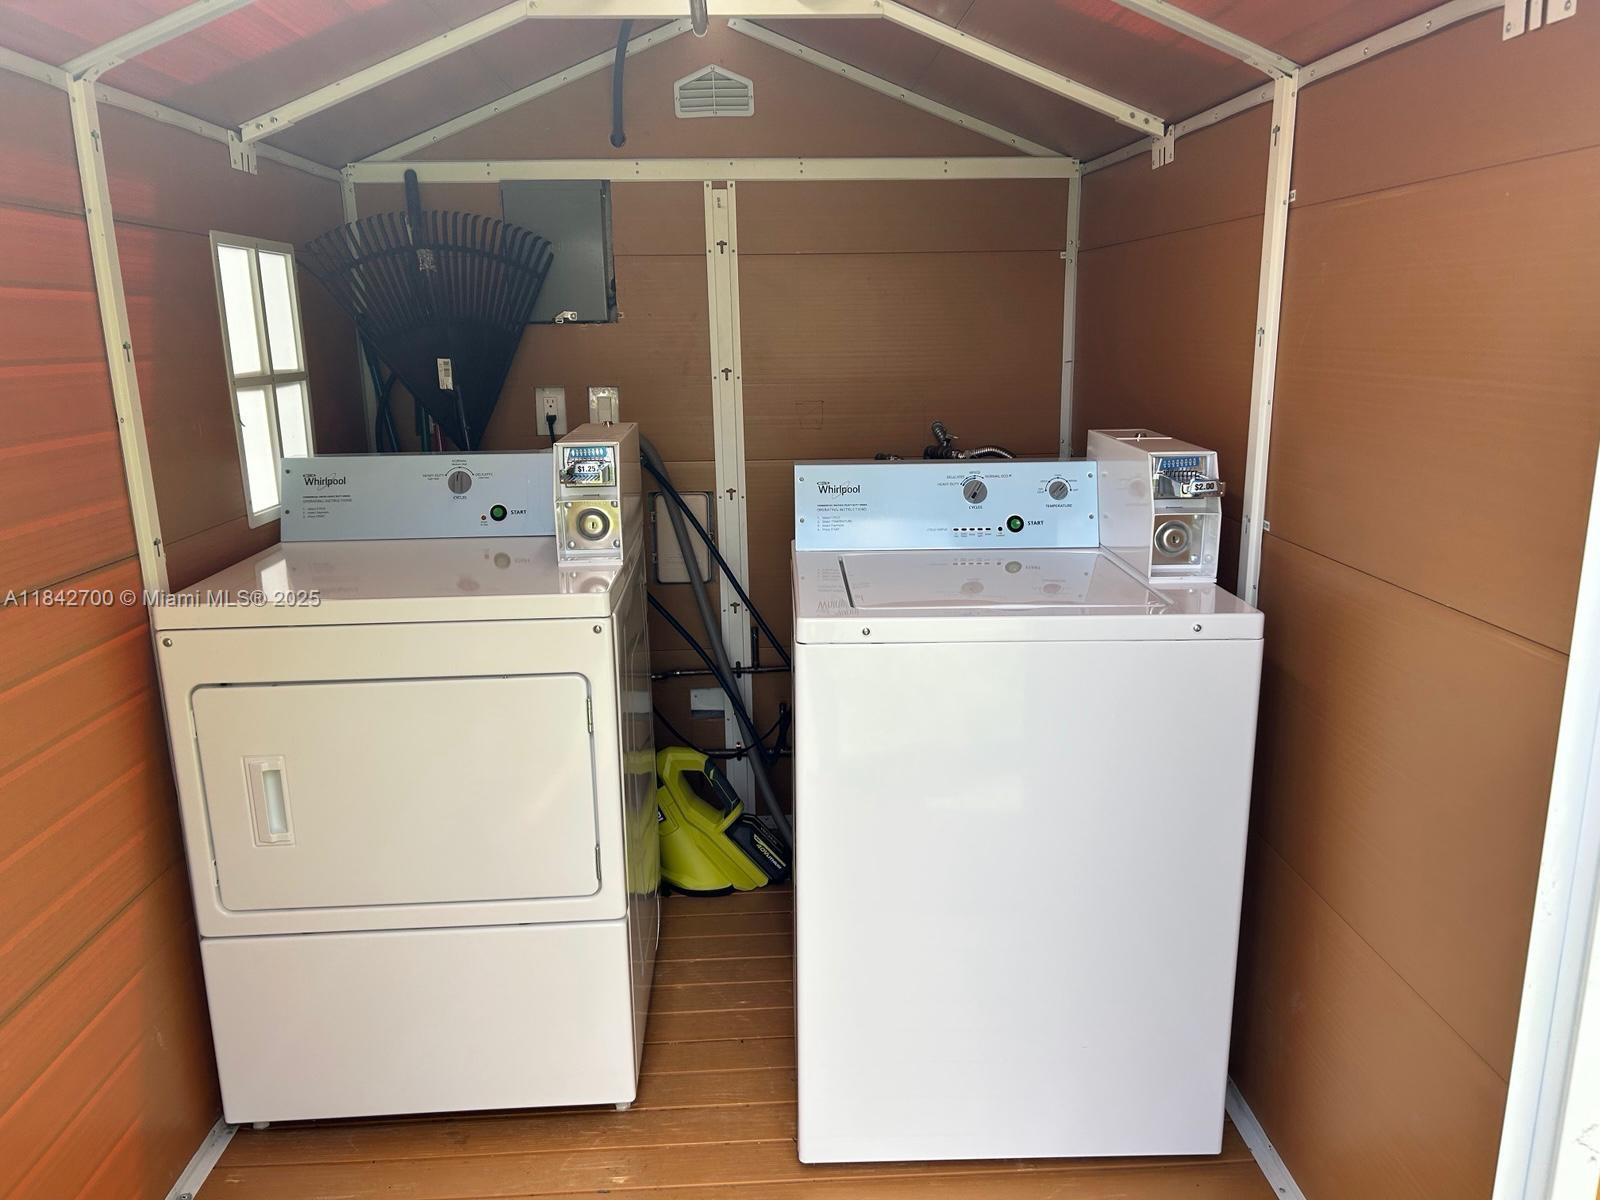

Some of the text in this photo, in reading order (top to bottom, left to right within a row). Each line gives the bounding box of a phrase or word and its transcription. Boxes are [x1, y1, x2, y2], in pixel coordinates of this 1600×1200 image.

[577, 465, 596, 473] $1.25
[304, 476, 346, 488] Whirlpool
[1194, 482, 1215, 491] $2.00
[818, 484, 861, 496] Whirlpool
